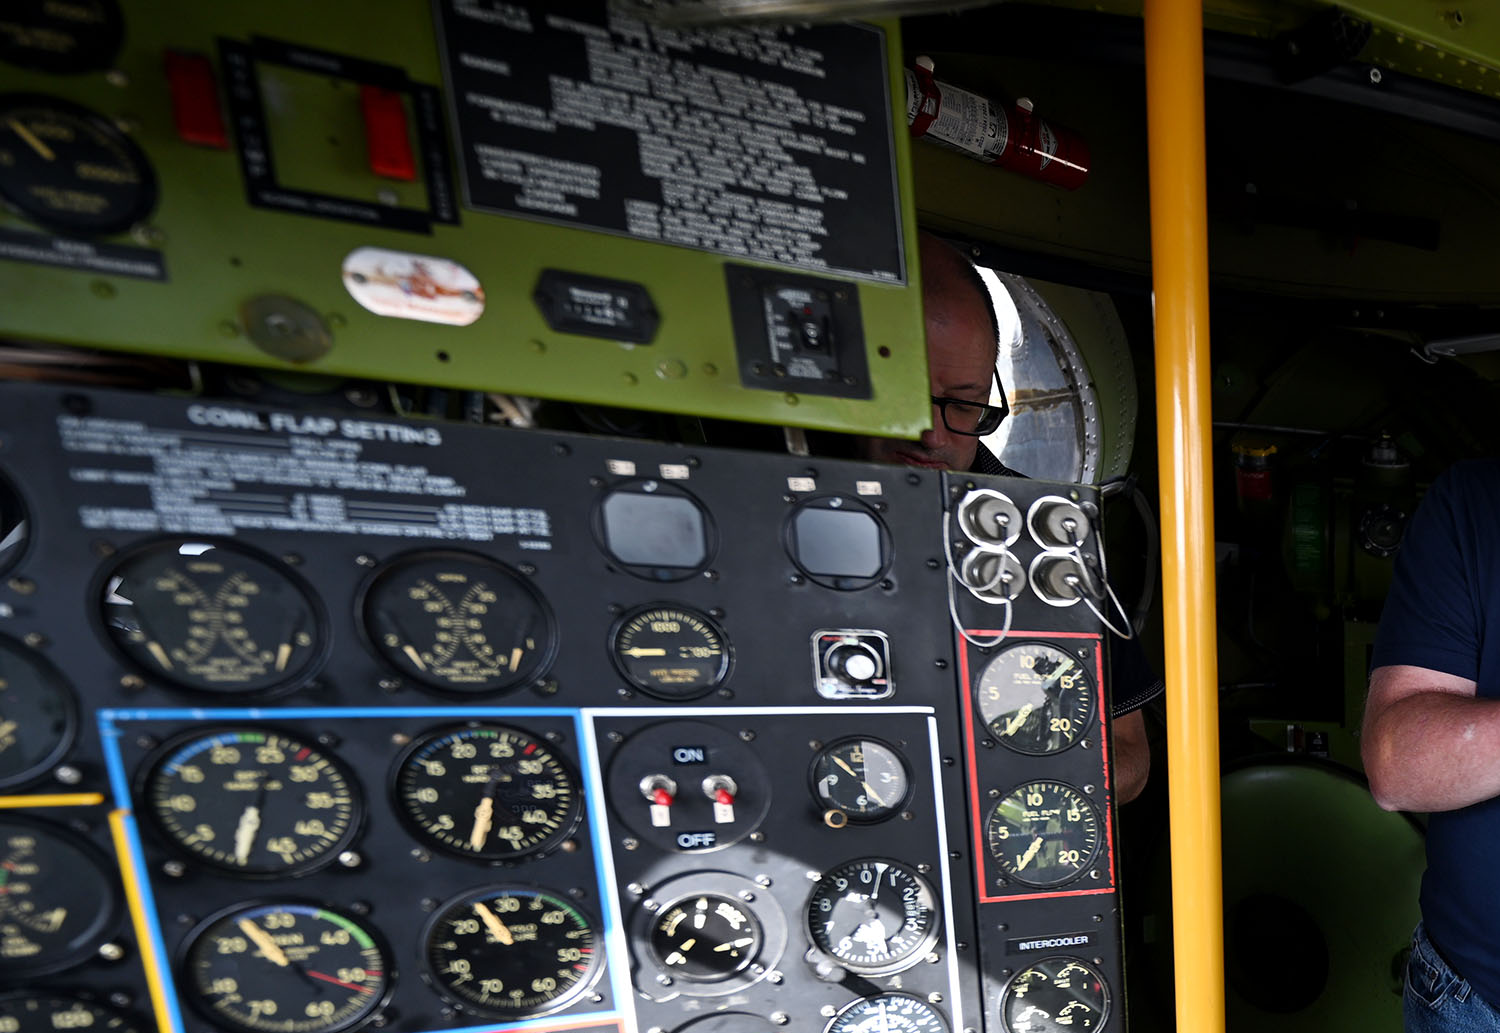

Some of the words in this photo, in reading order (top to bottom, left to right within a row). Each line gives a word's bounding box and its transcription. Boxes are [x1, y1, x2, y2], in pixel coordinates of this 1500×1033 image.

[187, 404, 268, 431] COWL
[269, 413, 337, 437] FLAP
[340, 418, 442, 446] SETTING
[1020, 655, 1035, 669] 10
[1061, 676, 1074, 689] 15
[988, 686, 1000, 700] 5
[1050, 718, 1071, 732] 20
[210, 747, 241, 764] 20
[255, 746, 286, 764] 25
[452, 744, 477, 759] 20
[489, 743, 515, 758] 25
[674, 748, 704, 763] ON
[289, 766, 319, 783] 30
[426, 760, 446, 776] 15
[518, 760, 543, 775] 30
[827, 774, 839, 786] 9
[416, 787, 439, 803] 10
[532, 784, 556, 799] 35
[306, 792, 335, 809] 35
[856, 795, 868, 806] 6
[1026, 793, 1043, 807] 10
[438, 815, 455, 831] 5
[522, 809, 547, 824] 40
[1066, 810, 1081, 822] 15
[295, 819, 325, 836] 40
[499, 826, 525, 841] 45
[998, 826, 1009, 840] 5
[266, 837, 297, 854] 45
[678, 833, 716, 848] OFF
[1058, 850, 1079, 863] 20
[835, 877, 849, 892] 9
[860, 870, 873, 884] 0
[890, 874, 897, 887] 1
[903, 887, 915, 900] 2
[495, 898, 521, 913] 30
[819, 898, 832, 912] 8
[264, 912, 296, 929] 30
[540, 911, 565, 925] 40
[905, 917, 918, 931] 3
[454, 919, 480, 935] 20
[320, 929, 350, 945] 40
[838, 936, 853, 950] 6
[1019, 936, 1089, 951] INTERCOOLER
[217, 936, 248, 954] 20
[557, 948, 581, 963] 50
[337, 967, 367, 984] 50
[531, 977, 557, 992] 60
[305, 1001, 336, 1018] 60
